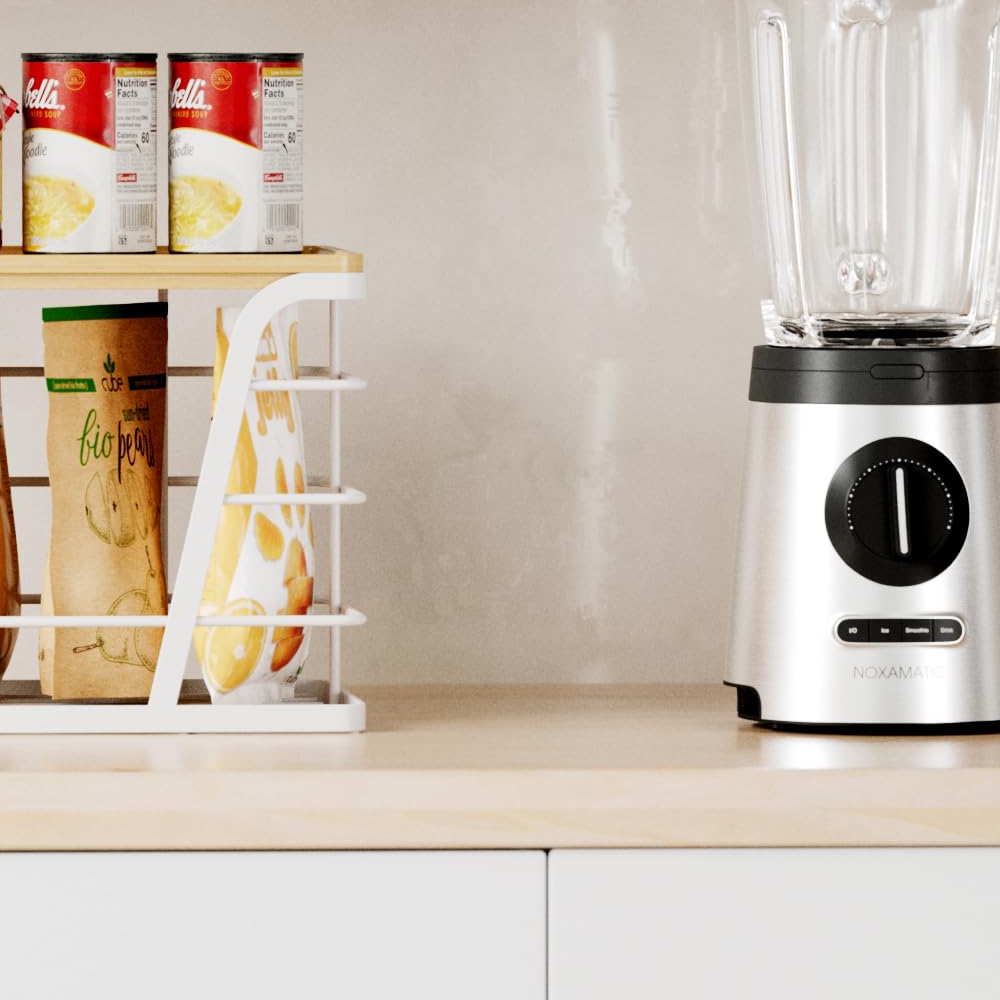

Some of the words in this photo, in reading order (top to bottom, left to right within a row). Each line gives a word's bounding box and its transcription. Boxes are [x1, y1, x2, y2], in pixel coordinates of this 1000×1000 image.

[117, 79, 148, 87] Nutrition
[264, 79, 294, 87] Nutrition
[117, 89, 138, 97] Facts
[264, 89, 285, 97] Facts
[76, 408, 115, 466] bio
